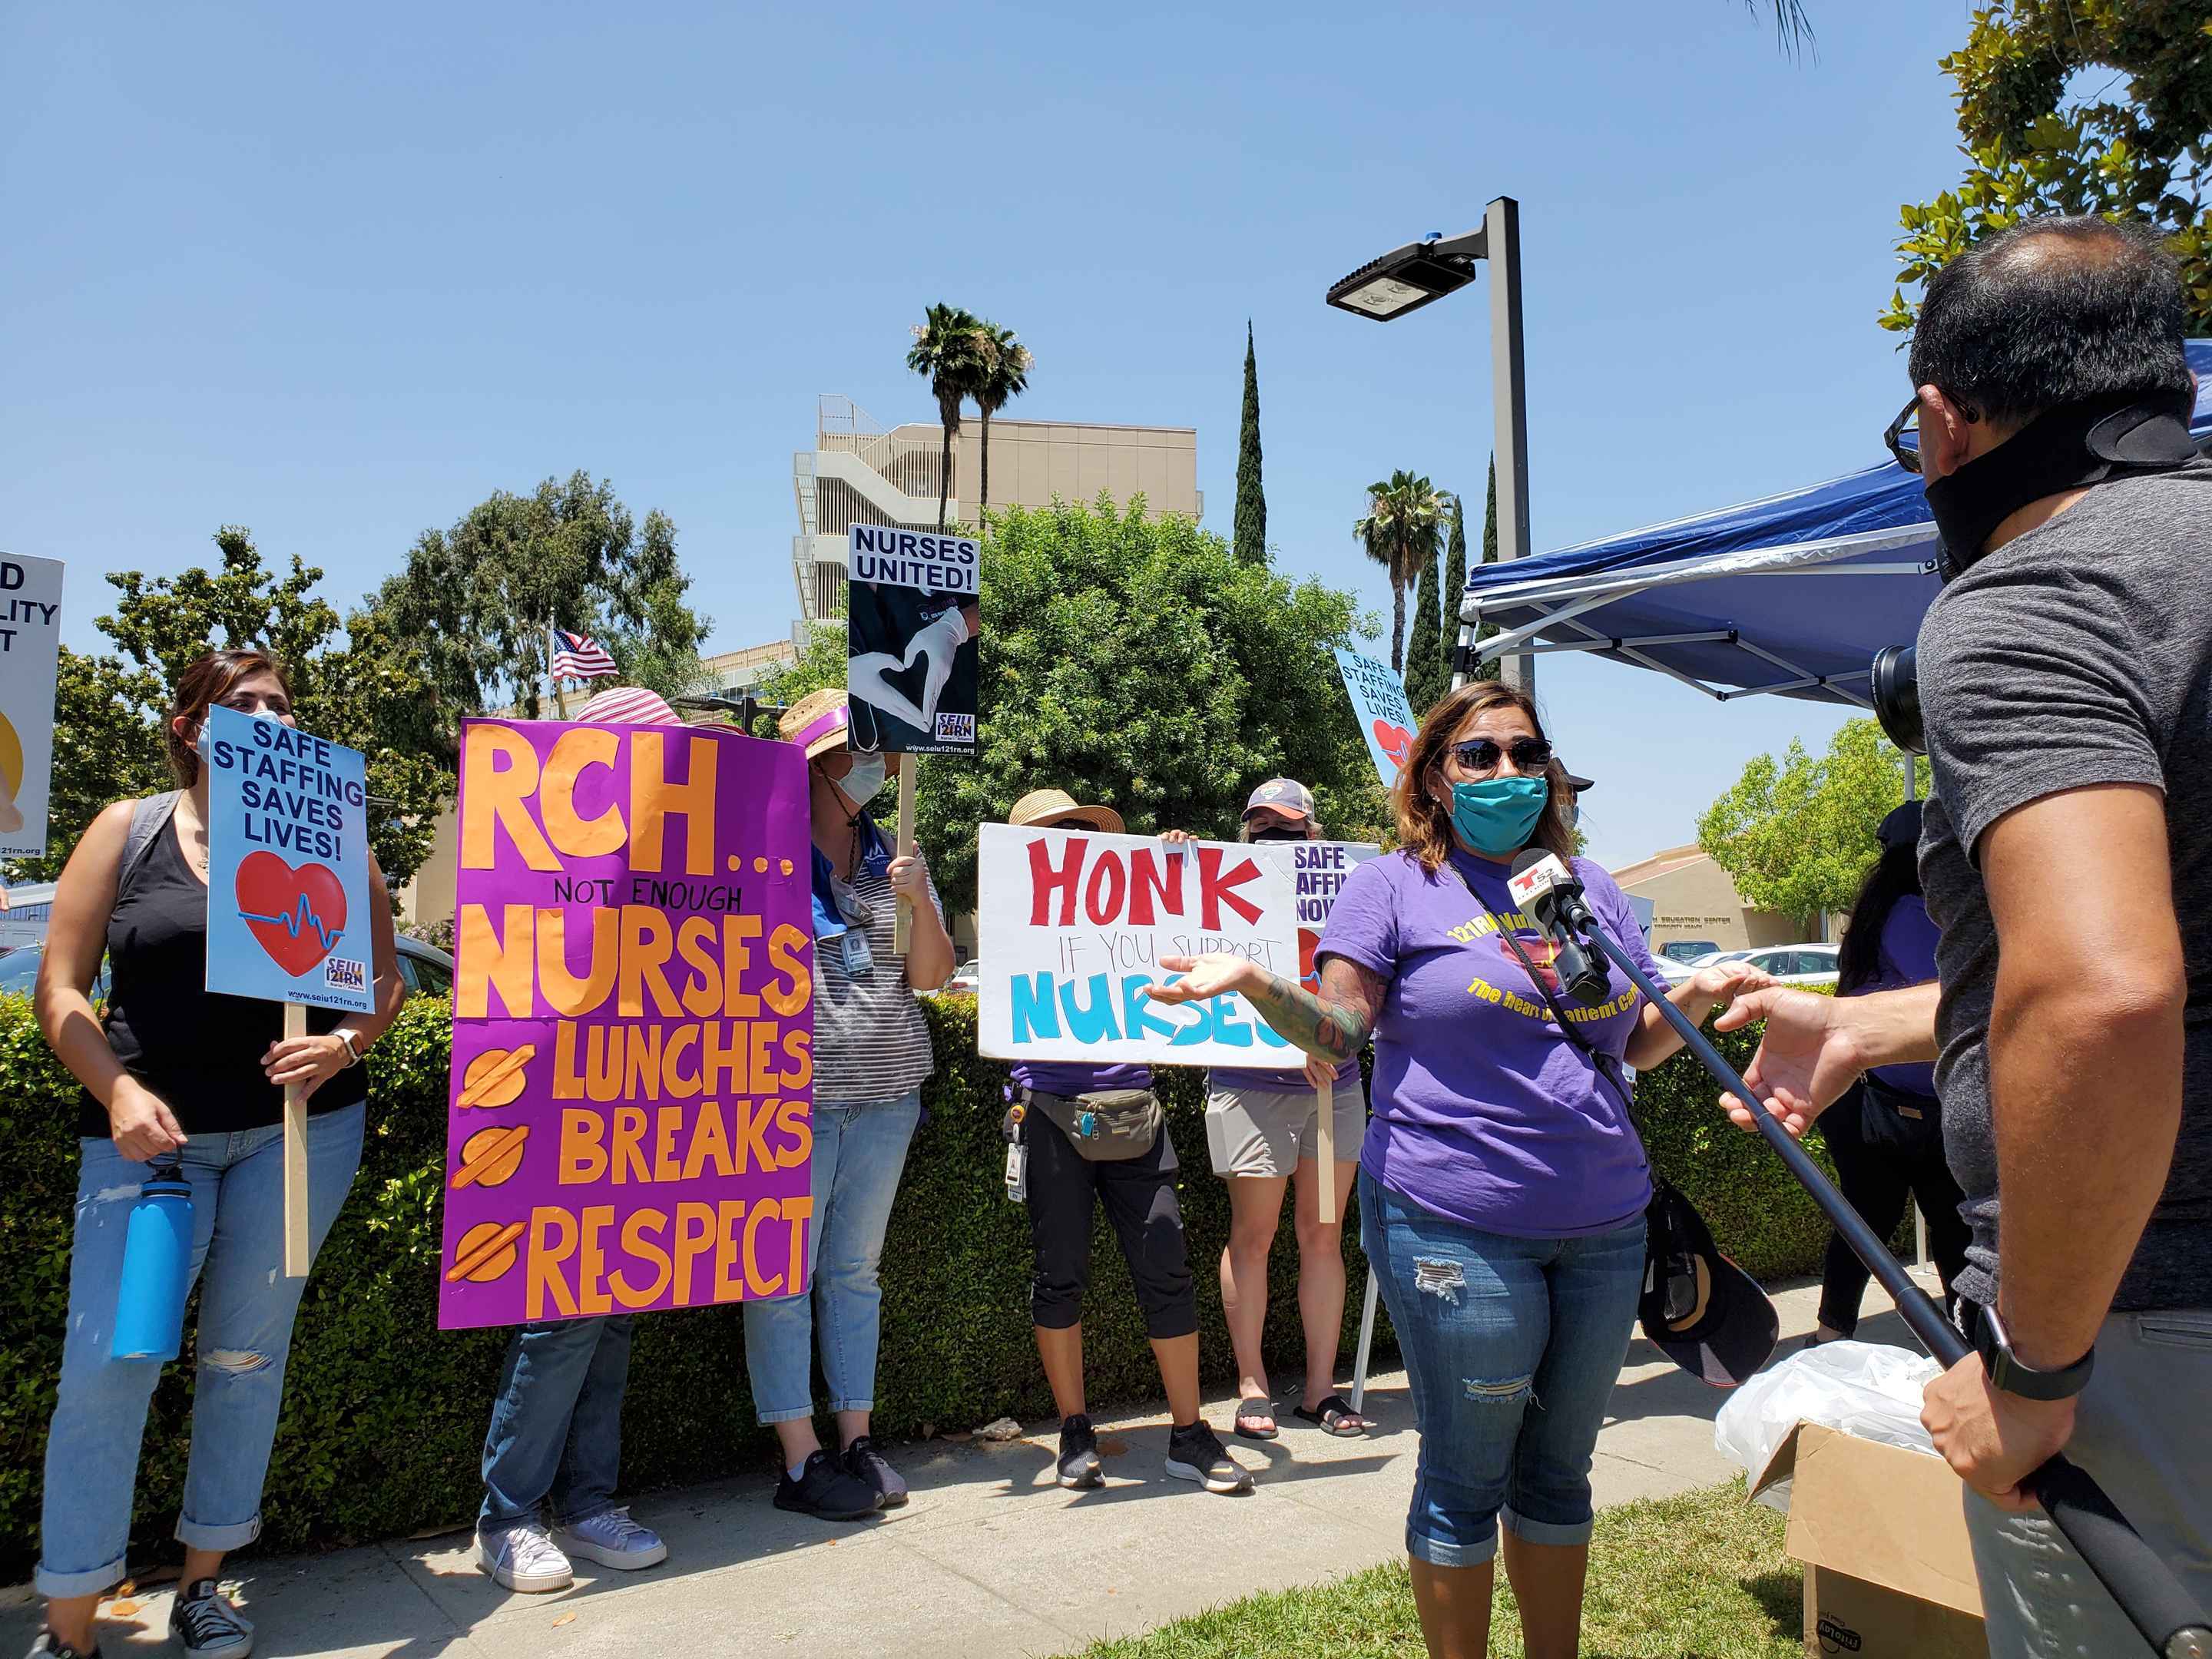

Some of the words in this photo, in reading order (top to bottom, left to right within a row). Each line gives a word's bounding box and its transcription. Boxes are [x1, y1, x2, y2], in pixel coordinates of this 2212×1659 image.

[856, 528, 975, 565] NURSES
[856, 555, 972, 591] UNITED!
[1343, 666, 1406, 700] STAFFING
[1353, 655, 1389, 679] SAFE
[1359, 685, 1403, 711] SAVES
[1366, 701, 1409, 727] LIVES!
[939, 714, 972, 727] SEIU
[252, 720, 331, 768] SAFE
[906, 745, 975, 755] www.seiu121rn.org
[214, 740, 363, 807] STAFFING
[241, 780, 343, 831] SAVES
[0, 846, 41, 856] 21rn.org
[244, 813, 343, 862] LIVES!
[1294, 846, 1345, 869] SAFE
[554, 876, 615, 906] NOT
[632, 877, 742, 912] ENOUGH
[1026, 836, 1264, 932] HONK
[328, 958, 363, 974] SEIU
[455, 902, 813, 1020] NURSES
[1059, 935, 1088, 974] IF
[1098, 931, 1155, 973] YOU
[288, 990, 367, 1009] www.seiu121rn.org
[1466, 977, 1502, 1004] The
[1564, 1001, 1618, 1023] atient
[552, 1019, 813, 1104] LUNCHES
[558, 1097, 813, 1186] BREAKS
[525, 1195, 813, 1320] RESPECT
